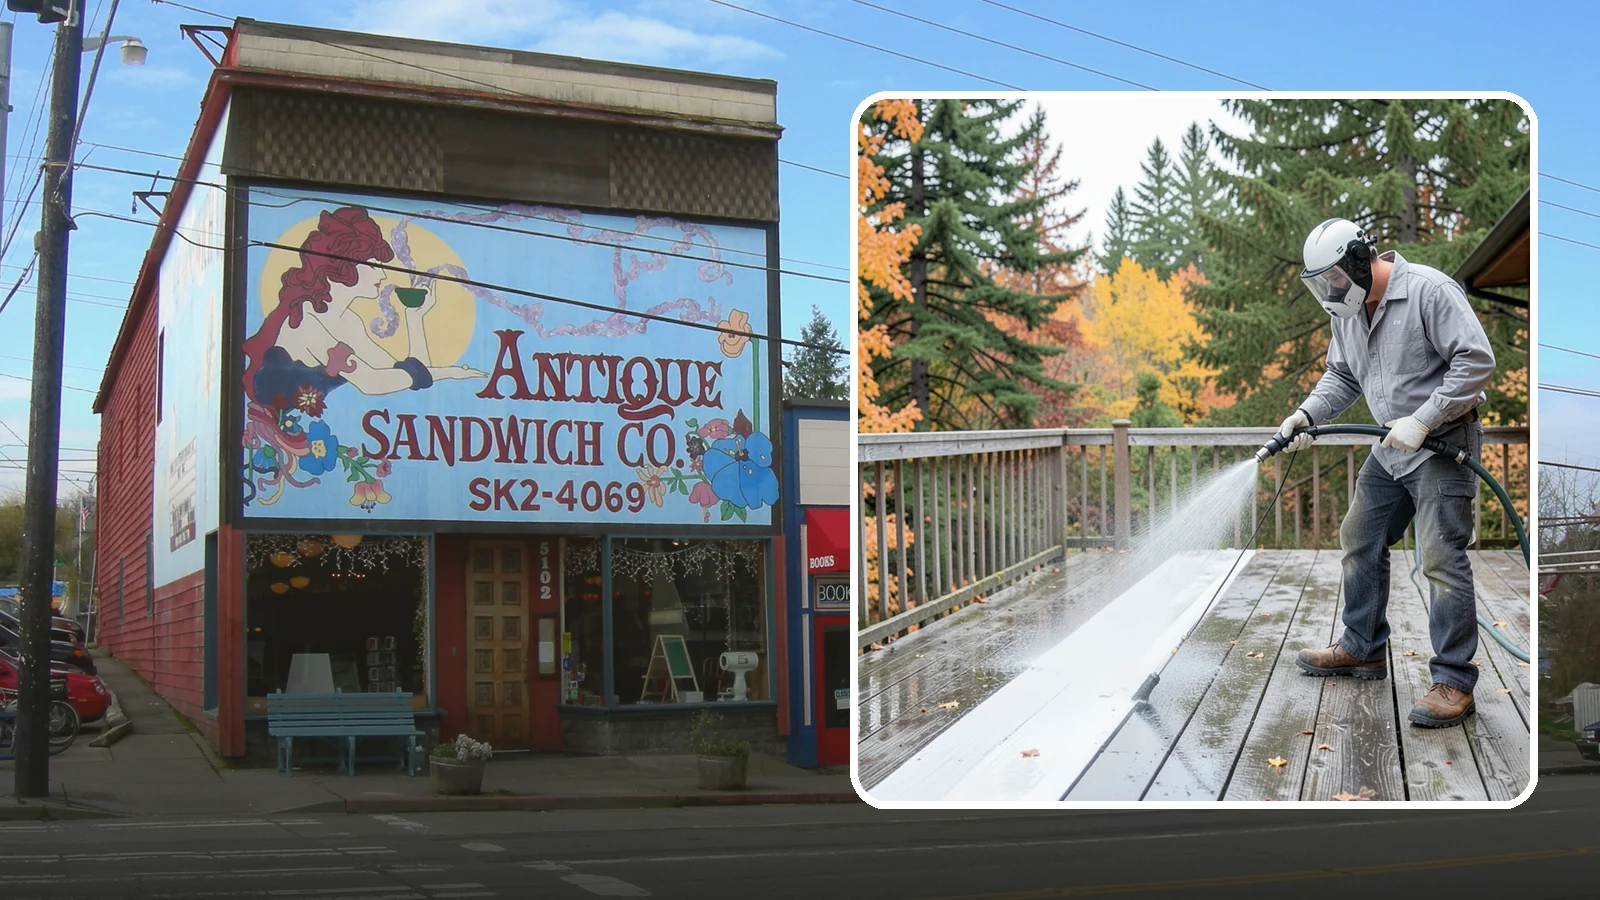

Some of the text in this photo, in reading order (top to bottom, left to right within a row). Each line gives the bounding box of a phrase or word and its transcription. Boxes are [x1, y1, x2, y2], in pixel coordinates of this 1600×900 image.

[476, 330, 723, 421] ANTIQUE
[361, 408, 685, 468] SANDWICH CO.
[468, 477, 646, 513] SK2-4069
[540, 541, 551, 599] 5102
[809, 555, 834, 569] BOOKS
